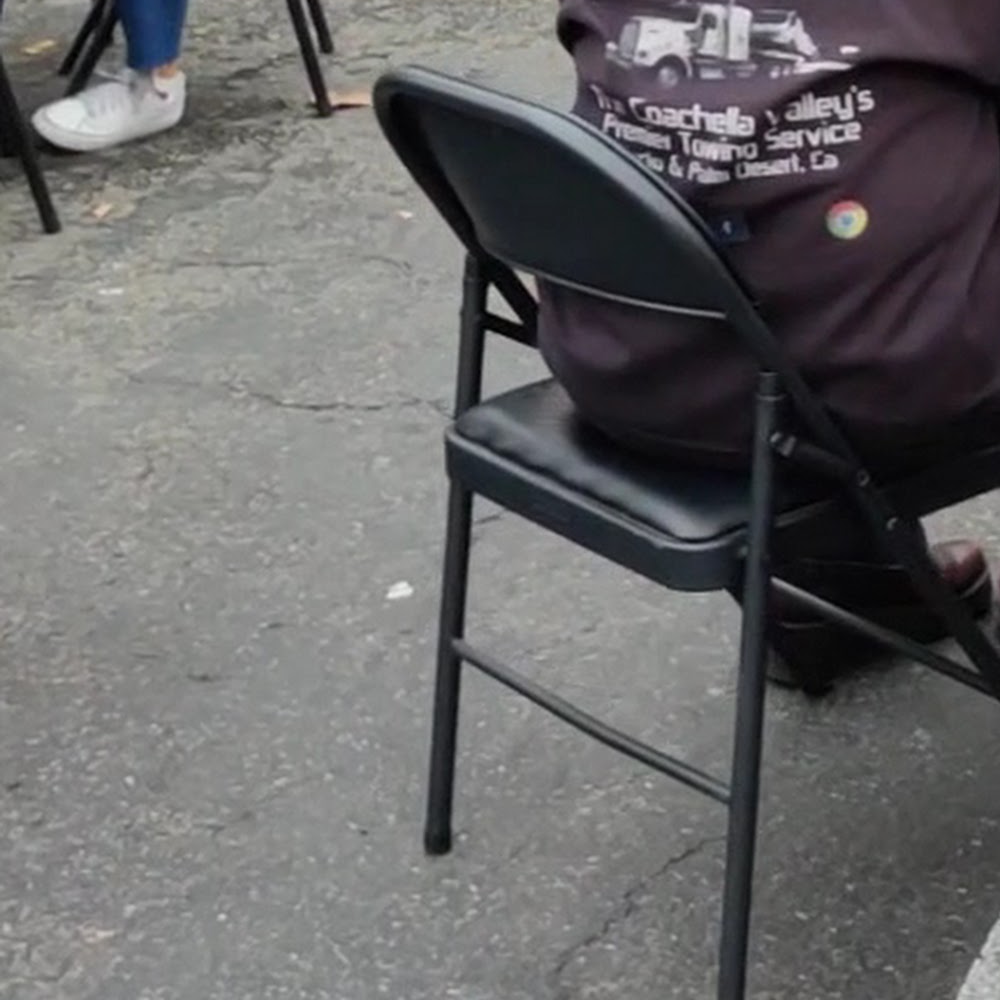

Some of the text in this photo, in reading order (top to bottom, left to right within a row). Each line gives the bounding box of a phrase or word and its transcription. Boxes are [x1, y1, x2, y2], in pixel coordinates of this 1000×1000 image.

[629, 96, 756, 137] Coachella
[677, 130, 759, 163] Towing
[763, 119, 863, 151] Service
